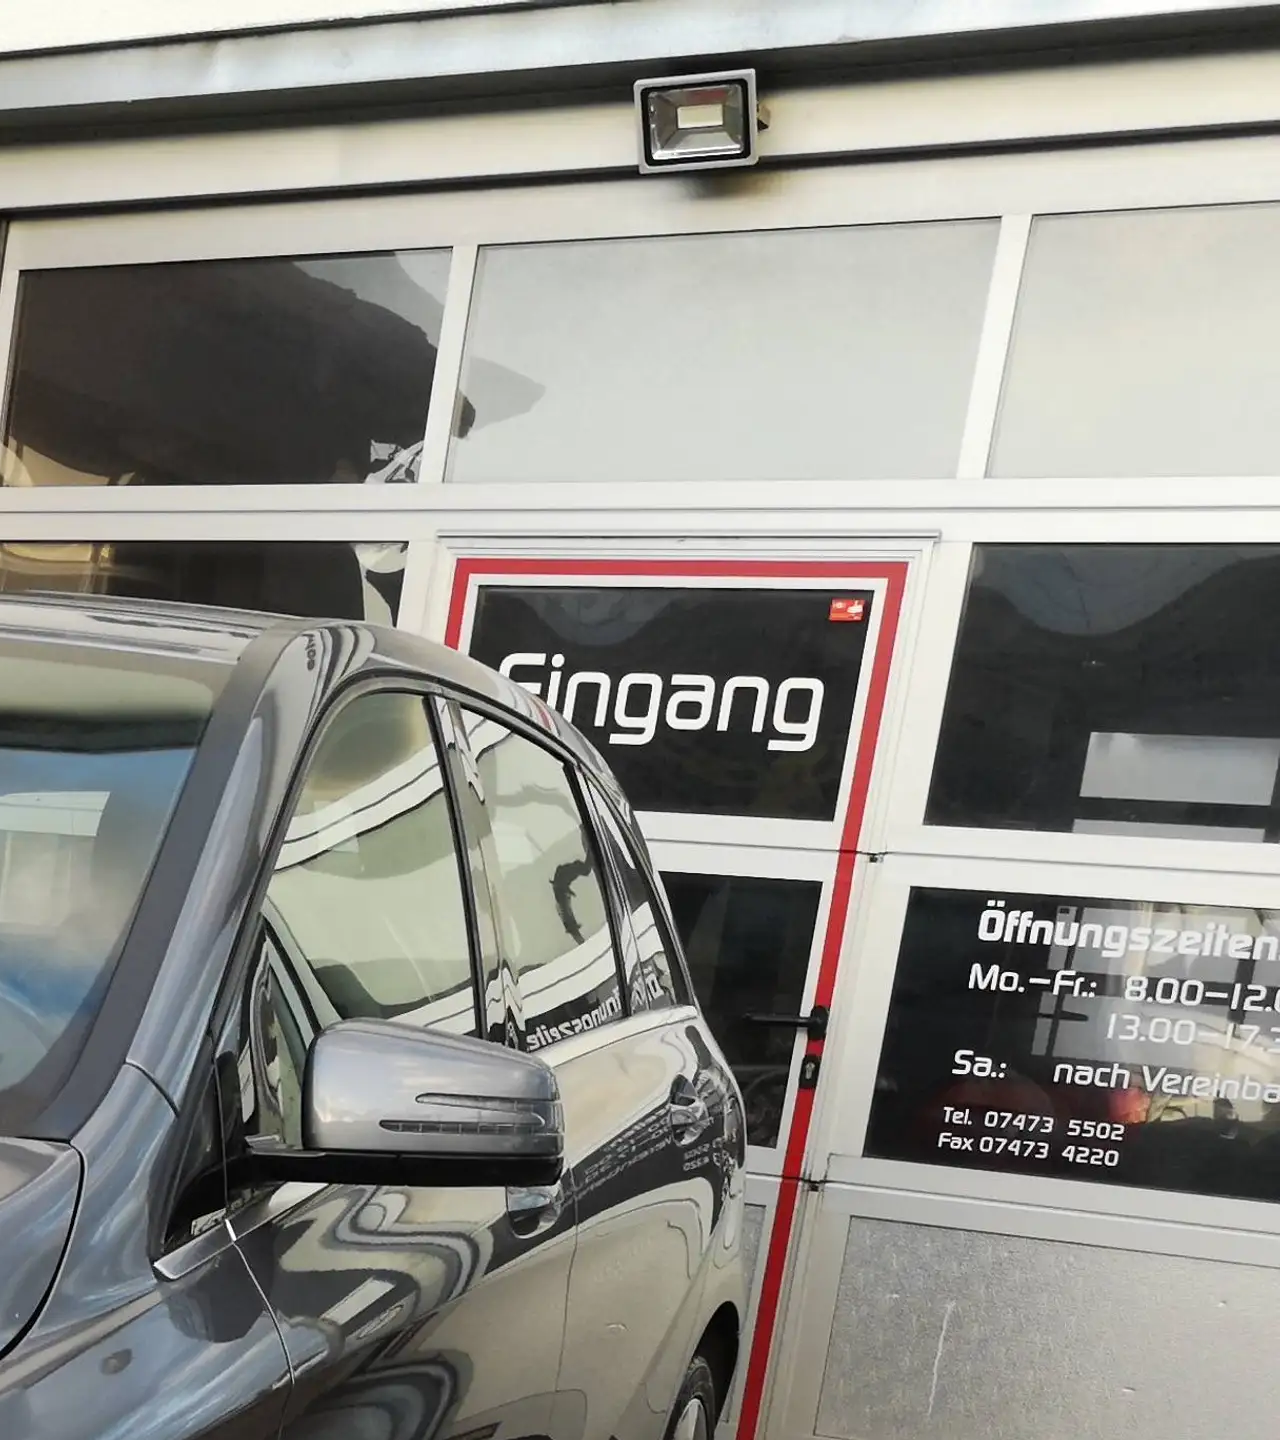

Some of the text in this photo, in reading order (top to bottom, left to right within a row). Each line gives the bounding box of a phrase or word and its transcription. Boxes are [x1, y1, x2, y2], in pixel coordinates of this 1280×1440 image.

[978, 900, 1280, 961] Öffnungszeiten
[1124, 975, 1280, 1013] 8.00-12.
[951, 1049, 1007, 1079] Sa.:
[1053, 1063, 1131, 1089] nach
[943, 1106, 1125, 1141] Tel. 07473 5502
[938, 1132, 1120, 1167] Fax 07473 4220
